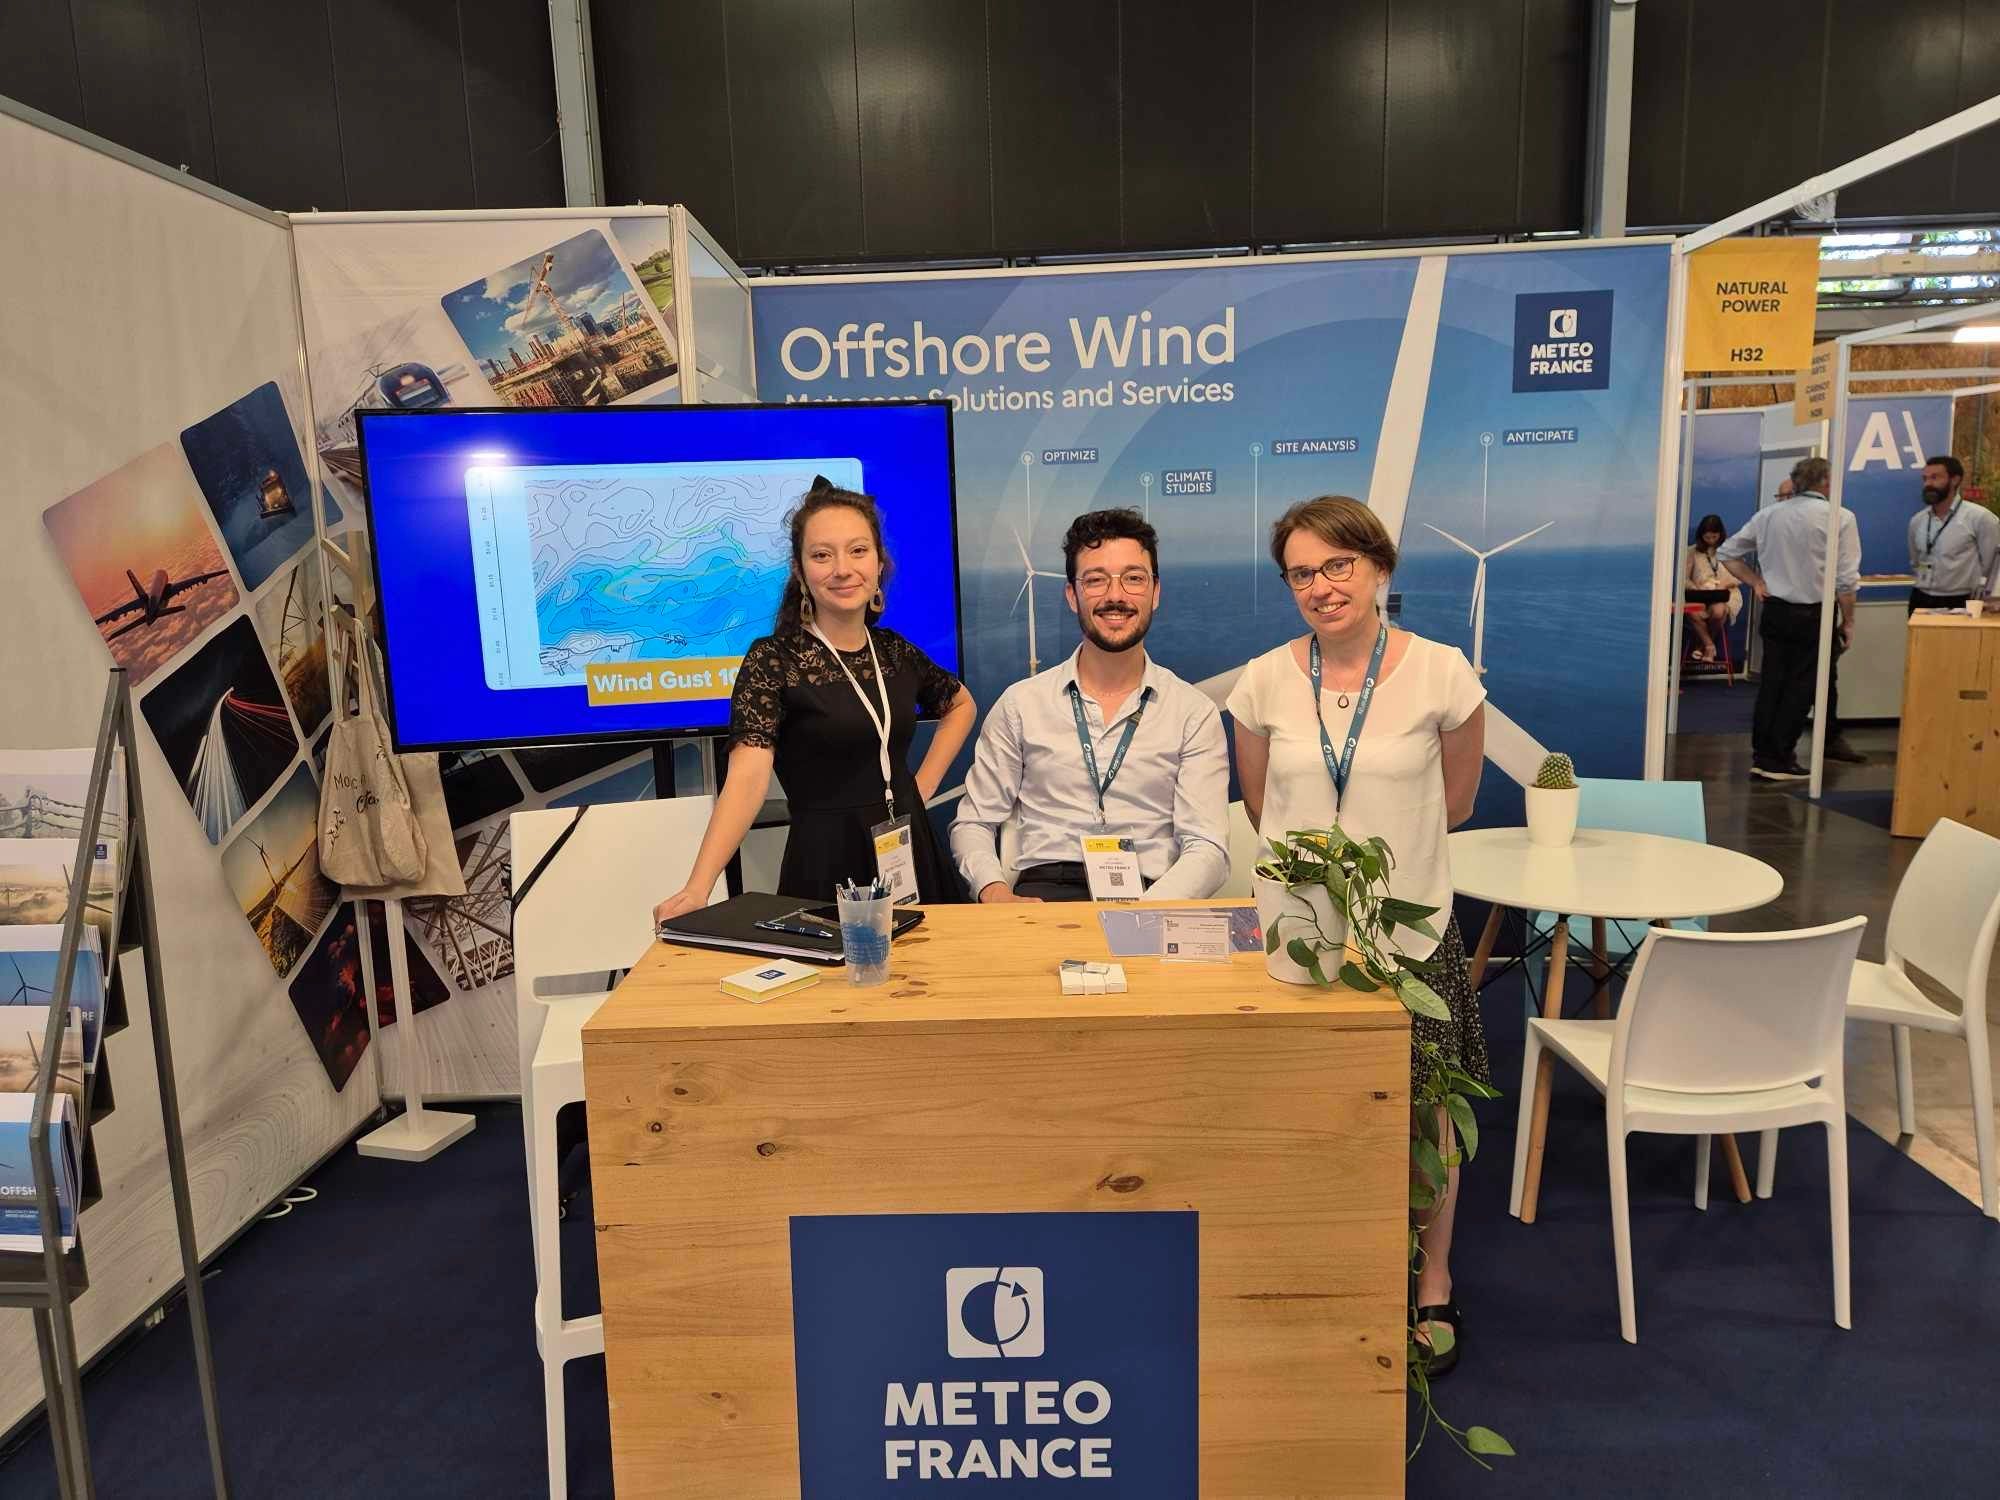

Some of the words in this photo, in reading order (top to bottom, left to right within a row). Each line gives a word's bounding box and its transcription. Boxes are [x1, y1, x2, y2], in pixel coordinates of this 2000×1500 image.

[1716, 281, 1788, 295] NATURAL
[1721, 299, 1780, 313] POWER
[779, 320, 1051, 381] Offshore
[1068, 306, 1236, 369] Wind
[1531, 342, 1594, 359] METEO
[1730, 347, 1763, 362] H32
[1530, 359, 1593, 375] FRANCE
[1062, 380, 1113, 409] and
[1122, 377, 1235, 406] Services
[1506, 430, 1575, 443] ANTICIPATE
[1275, 442, 1299, 454] SITE
[1302, 439, 1356, 452] ANALYSIS
[1044, 450, 1096, 463] OPTIMIZE
[1165, 470, 1213, 483] CLIMATE
[1165, 482, 1212, 494] STUDIES
[593, 672, 653, 693] Wind
[659, 670, 713, 689] Gust
[0, 1186, 62, 1196] OFFSHE
[884, 1379, 1112, 1426] METEO
[884, 1437, 1112, 1480] FRANCE
